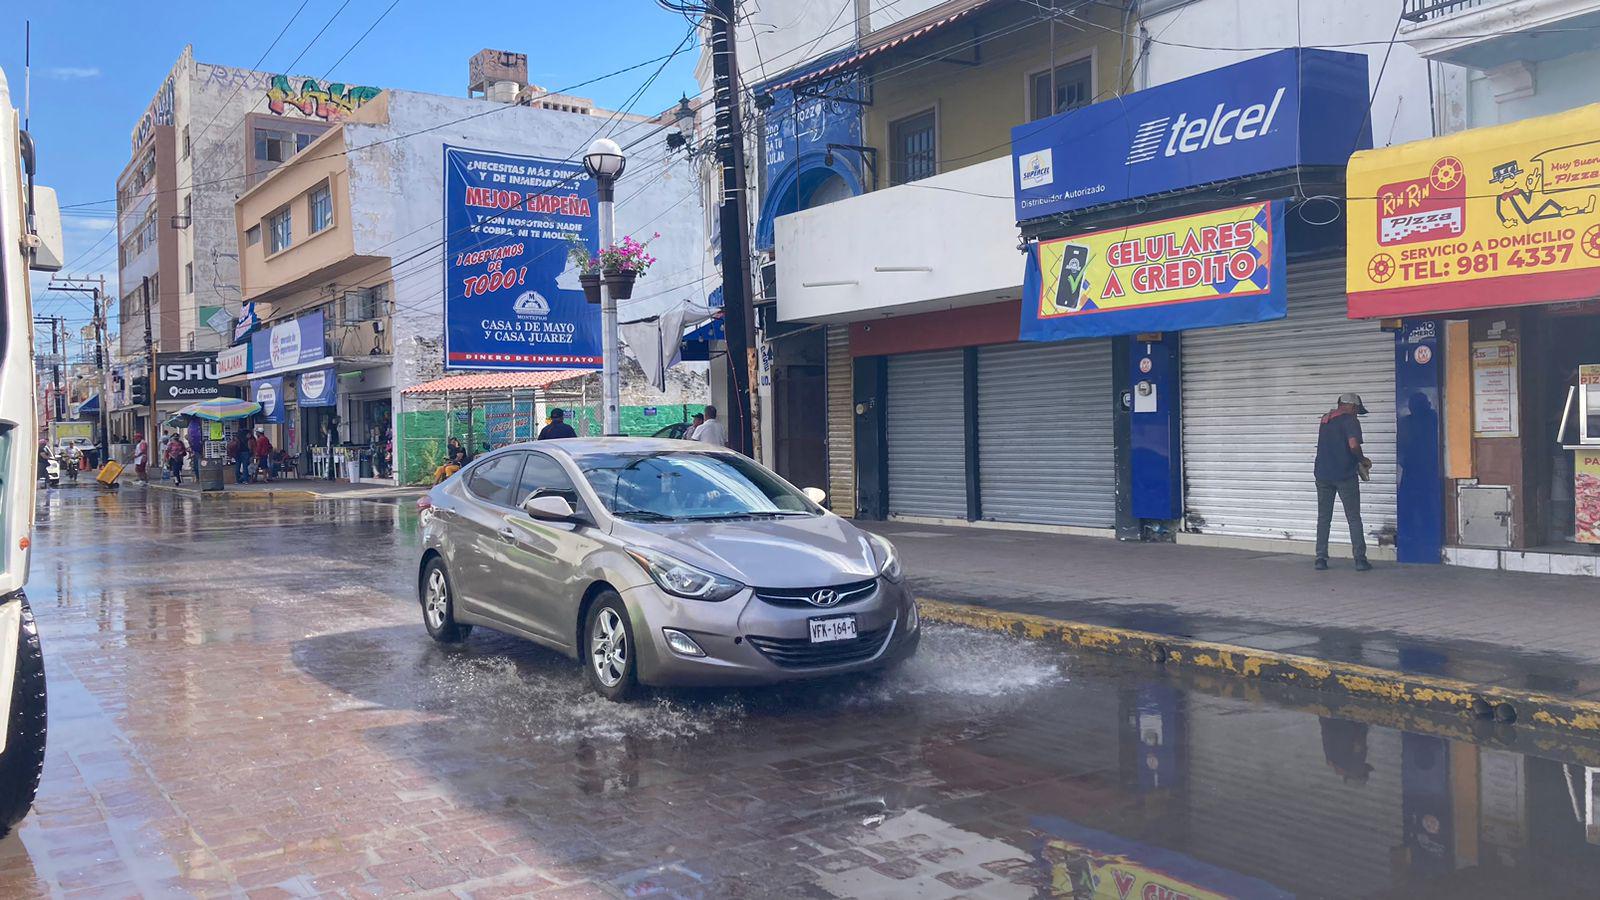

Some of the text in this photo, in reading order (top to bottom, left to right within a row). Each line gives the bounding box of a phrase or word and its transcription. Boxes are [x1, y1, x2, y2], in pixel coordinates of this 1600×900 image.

[1164, 86, 1286, 157] telcel
[467, 160, 524, 175] ¿NECESITAS
[526, 166, 550, 178] MÁS
[1551, 161, 1572, 172] Muy
[479, 172, 487, 181] Y
[493, 174, 506, 183] DE
[465, 186, 591, 217] MEJOR EMPEÑA
[1021, 184, 1106, 209] Distribuidor Autorizado
[477, 215, 484, 224] Y
[507, 218, 554, 230] NOSOTROS
[557, 222, 582, 232] NADIE
[1390, 212, 1453, 229] Pizza
[518, 228, 528, 237] NI
[531, 231, 541, 239] TE
[1106, 221, 1254, 267] CELULARES
[1401, 228, 1576, 261] SERVICIO A DOMICILIO
[487, 260, 502, 273] DE
[1399, 243, 1574, 281] TEL: 981 4337
[1101, 250, 1258, 300] A CREDITO
[481, 319, 575, 334] CASA 5 DE MAYO
[495, 331, 524, 342] CASA
[528, 332, 573, 344] JUAREZ
[465, 353, 511, 361] DINERO
[533, 355, 594, 363] INMEDIATO
